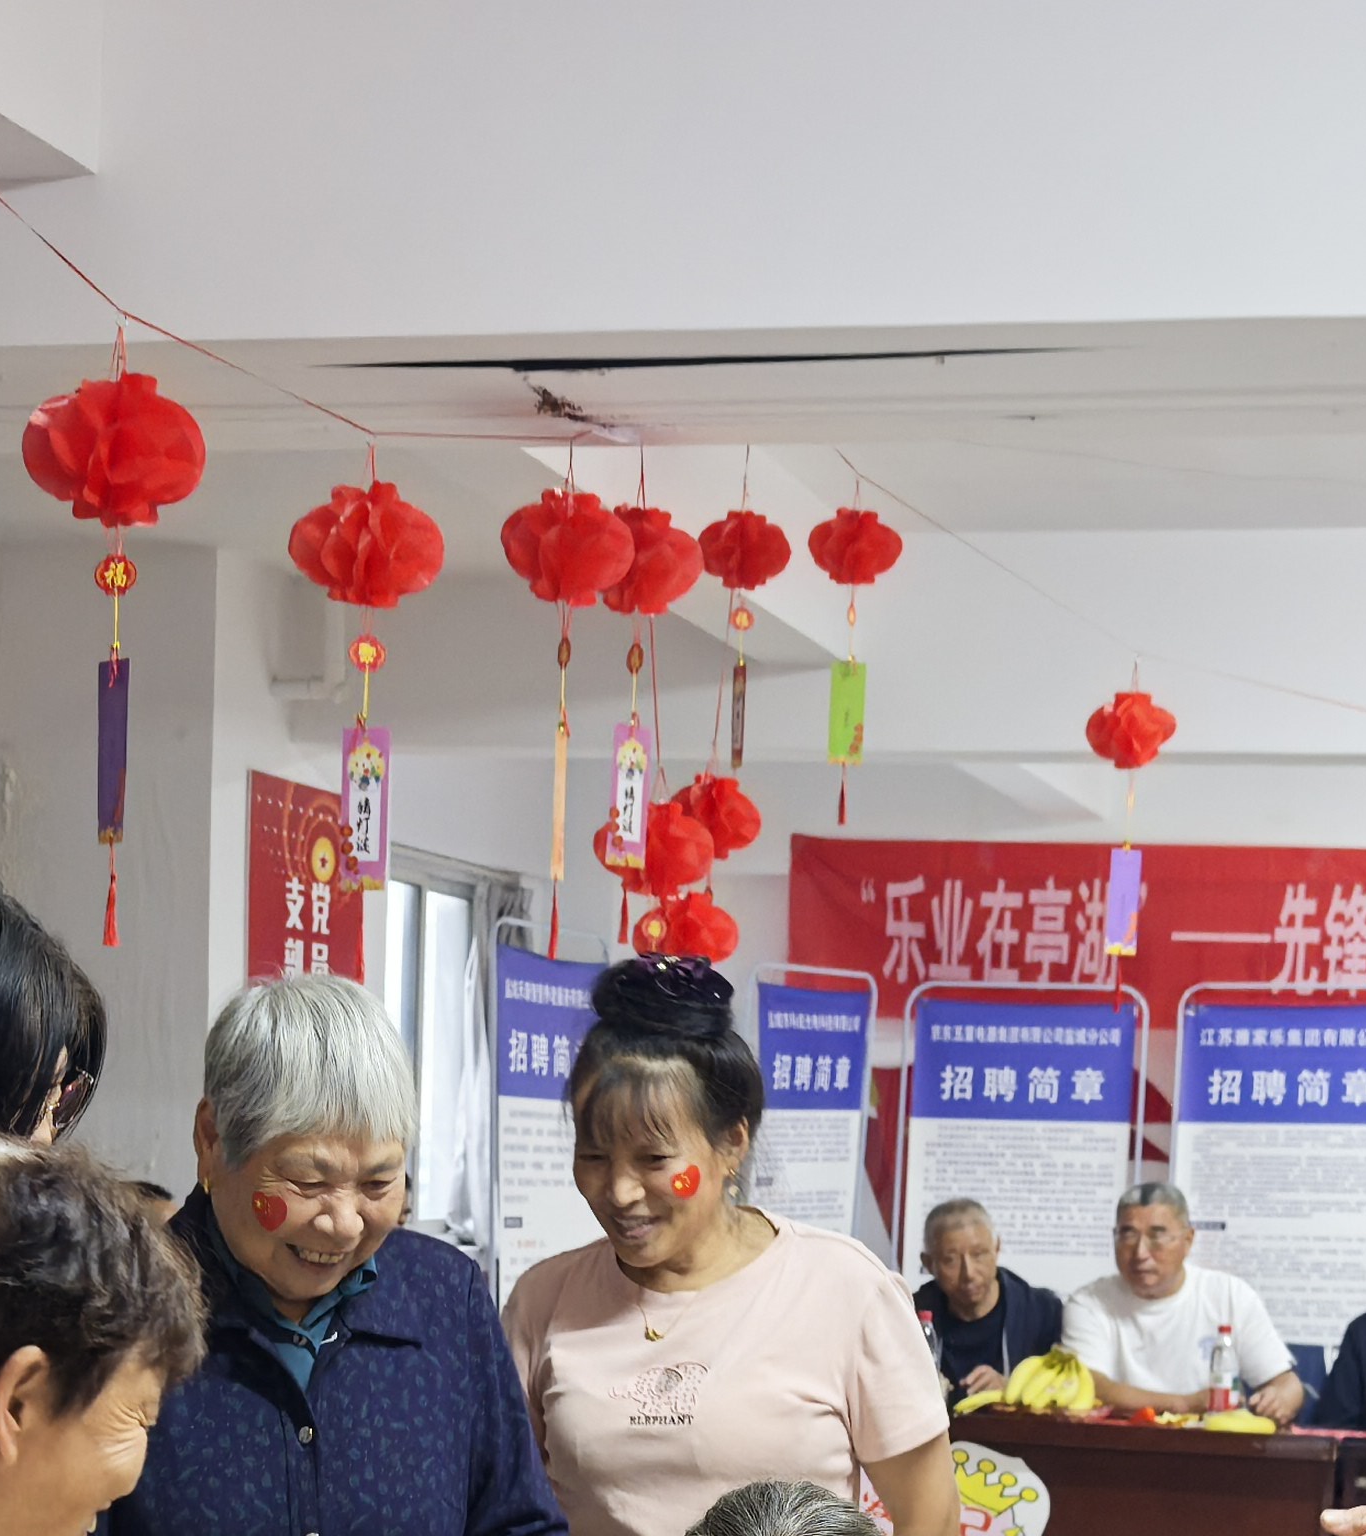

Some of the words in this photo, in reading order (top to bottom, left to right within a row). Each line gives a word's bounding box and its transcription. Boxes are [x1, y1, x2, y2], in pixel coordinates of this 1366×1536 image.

[509, 1028, 581, 1079] 招聘简
[772, 1052, 851, 1092] 招聘简章
[940, 1064, 1105, 1104] 招聘简章
